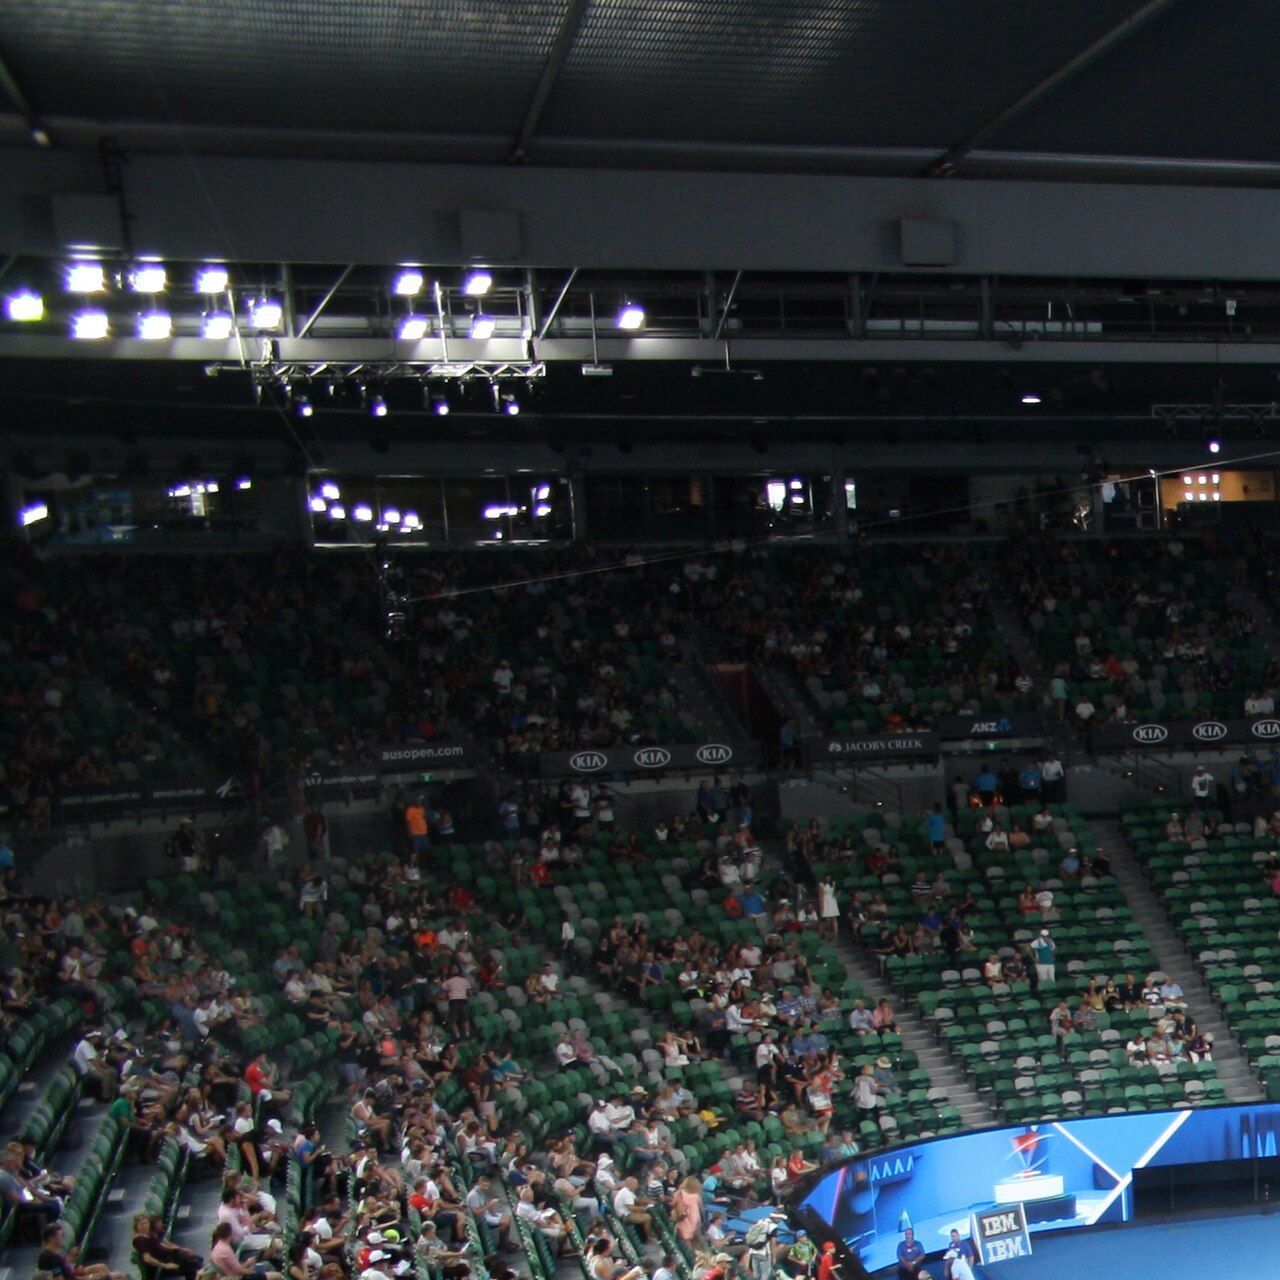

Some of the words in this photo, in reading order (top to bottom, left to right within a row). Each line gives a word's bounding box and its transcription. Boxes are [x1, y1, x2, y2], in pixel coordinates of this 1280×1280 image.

[971, 722, 998, 733] ANZ
[1137, 728, 1163, 739] KIA
[1198, 725, 1222, 737] KIA
[1256, 723, 1280, 735] KIA
[887, 739, 923, 749] CREEK
[382, 745, 464, 761] ausopen.com
[638, 752, 664, 764] KIA
[699, 748, 727, 760] KIA
[575, 755, 602, 768] KIA
[983, 1212, 1019, 1236] IBM
[986, 1236, 1026, 1263] IBM
